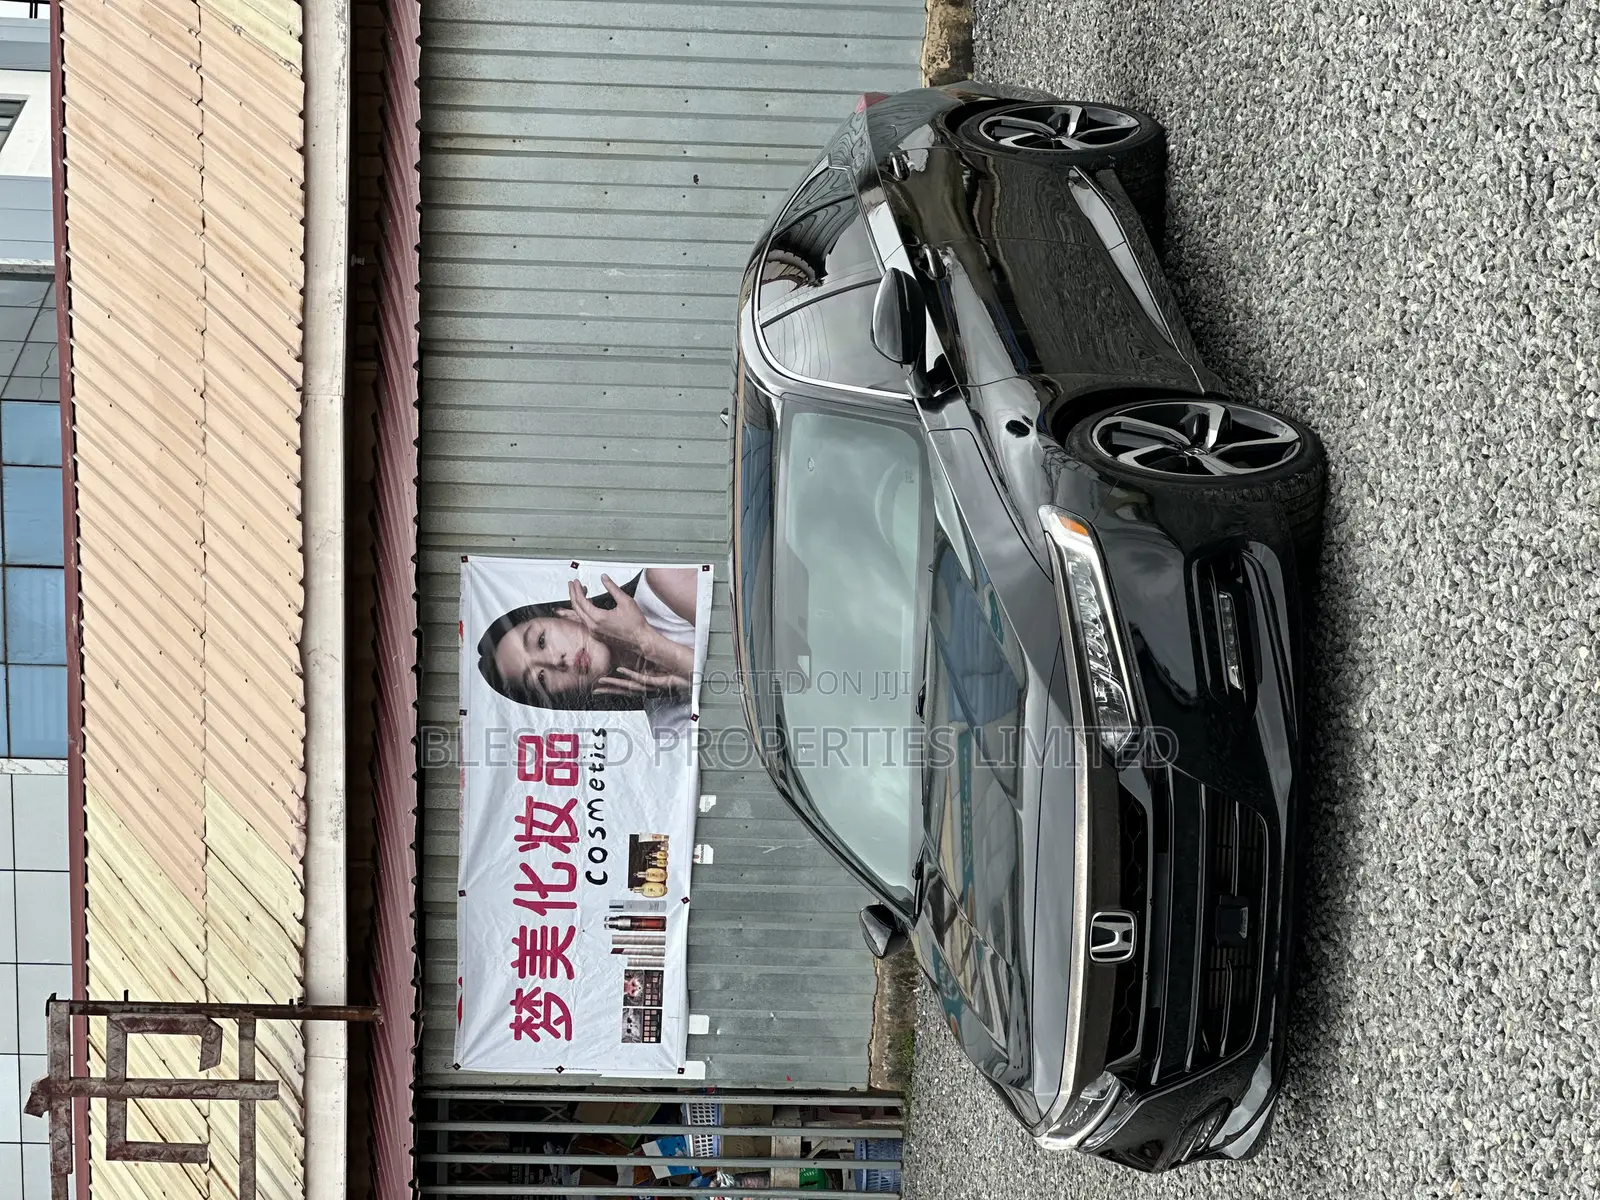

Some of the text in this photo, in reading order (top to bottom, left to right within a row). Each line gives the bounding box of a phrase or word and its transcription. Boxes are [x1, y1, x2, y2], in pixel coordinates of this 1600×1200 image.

[509, 733, 580, 1042] 梦美化妆品
